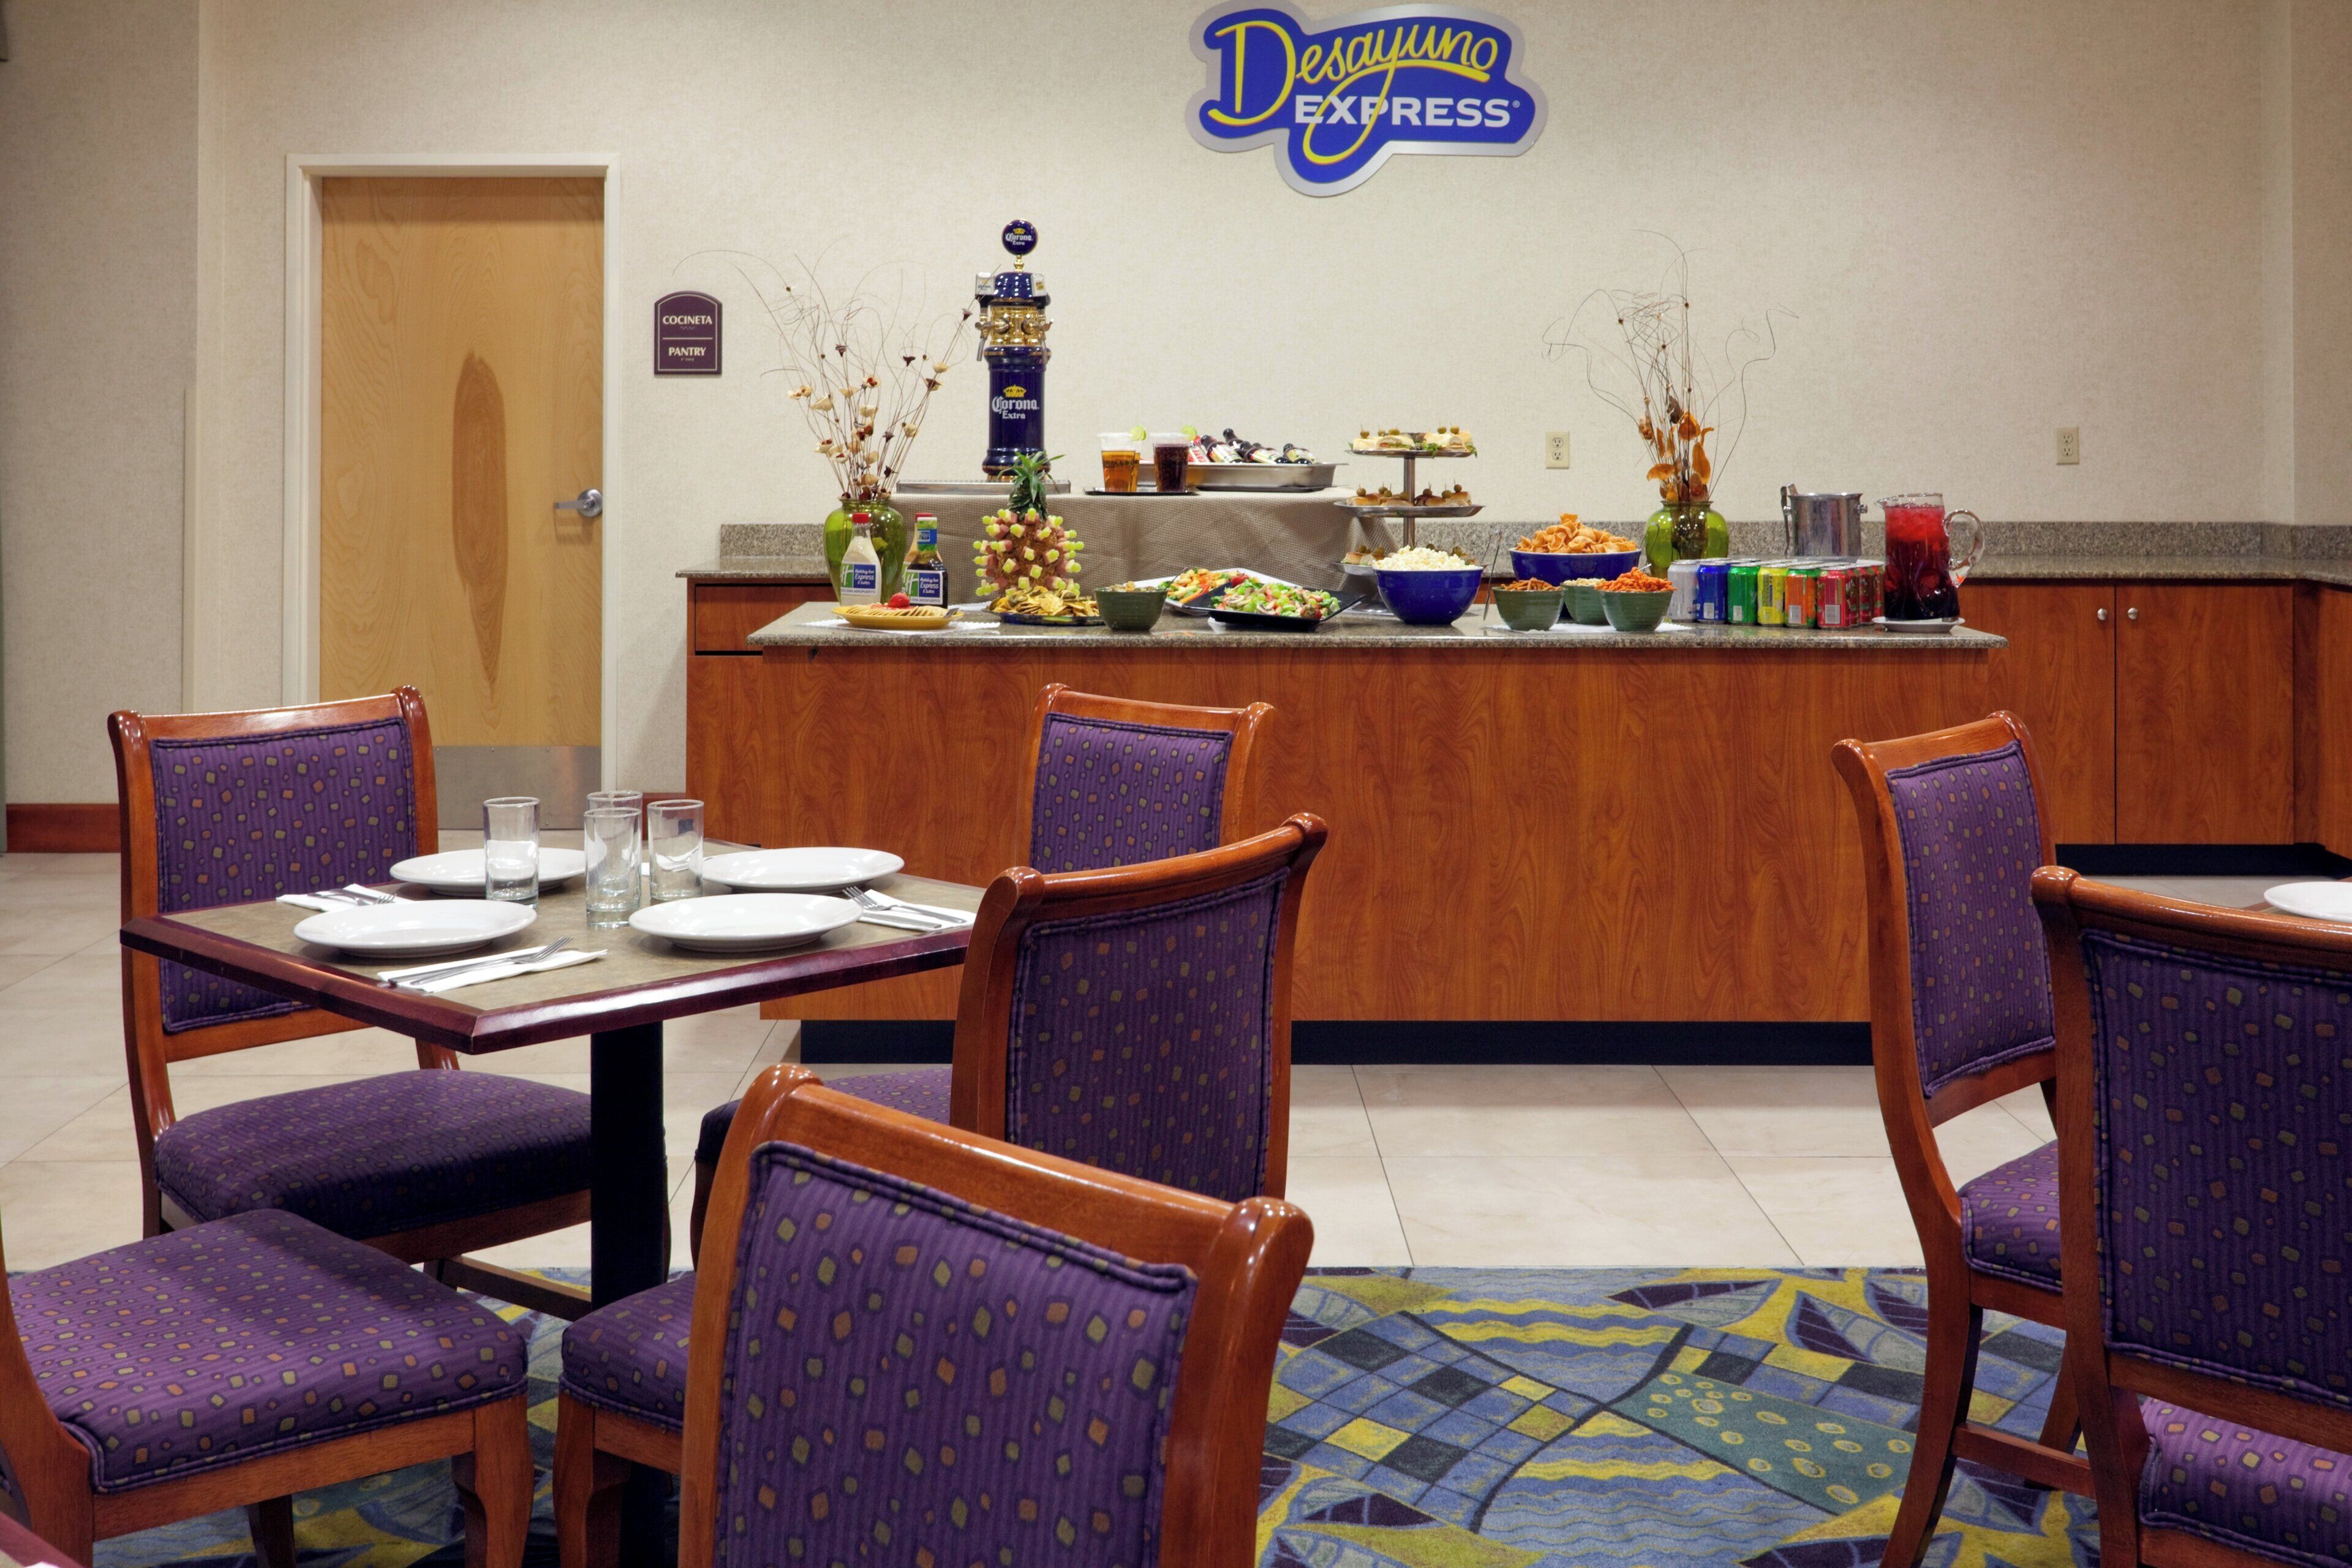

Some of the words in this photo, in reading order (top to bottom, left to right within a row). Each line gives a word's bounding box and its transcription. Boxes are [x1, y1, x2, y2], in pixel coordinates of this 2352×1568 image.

[1207, 20, 1498, 165] Desayuno
[1005, 233, 1033, 243] Corona
[662, 315, 713, 325] COCINETA
[668, 347, 707, 356] PANTRY
[992, 396, 1038, 415] Corona
[1002, 410, 1026, 419] Extra
